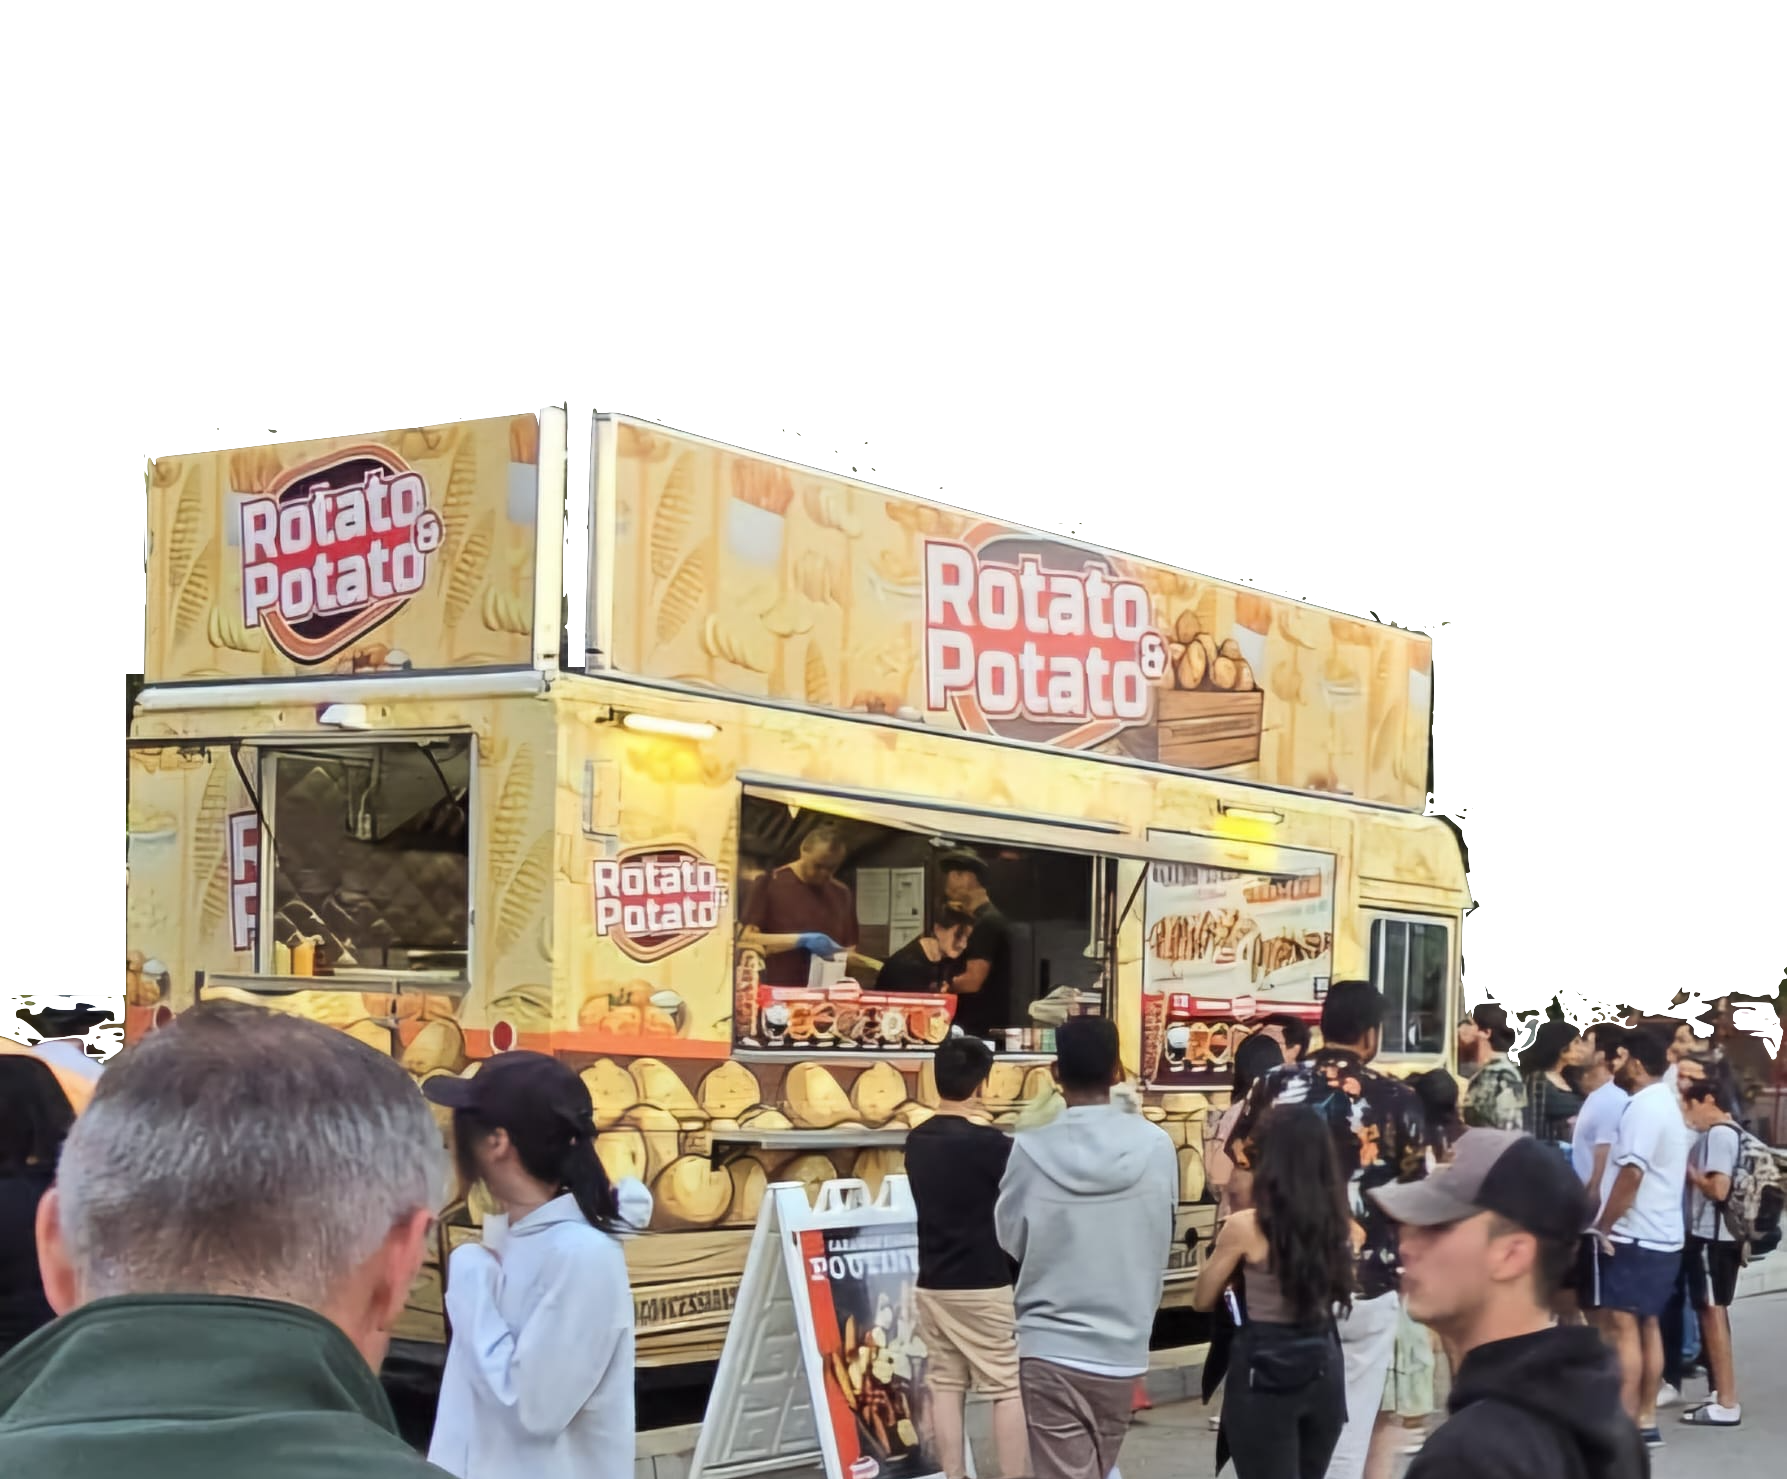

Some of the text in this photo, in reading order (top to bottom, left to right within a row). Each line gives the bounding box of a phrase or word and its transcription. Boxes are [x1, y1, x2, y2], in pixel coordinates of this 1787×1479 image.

[242, 473, 421, 564] Rotato
[244, 539, 426, 627] Potato
[926, 541, 1149, 642] Rotato
[927, 627, 1150, 719] Potato
[594, 860, 717, 898] Rotato
[596, 896, 719, 936] Potato
